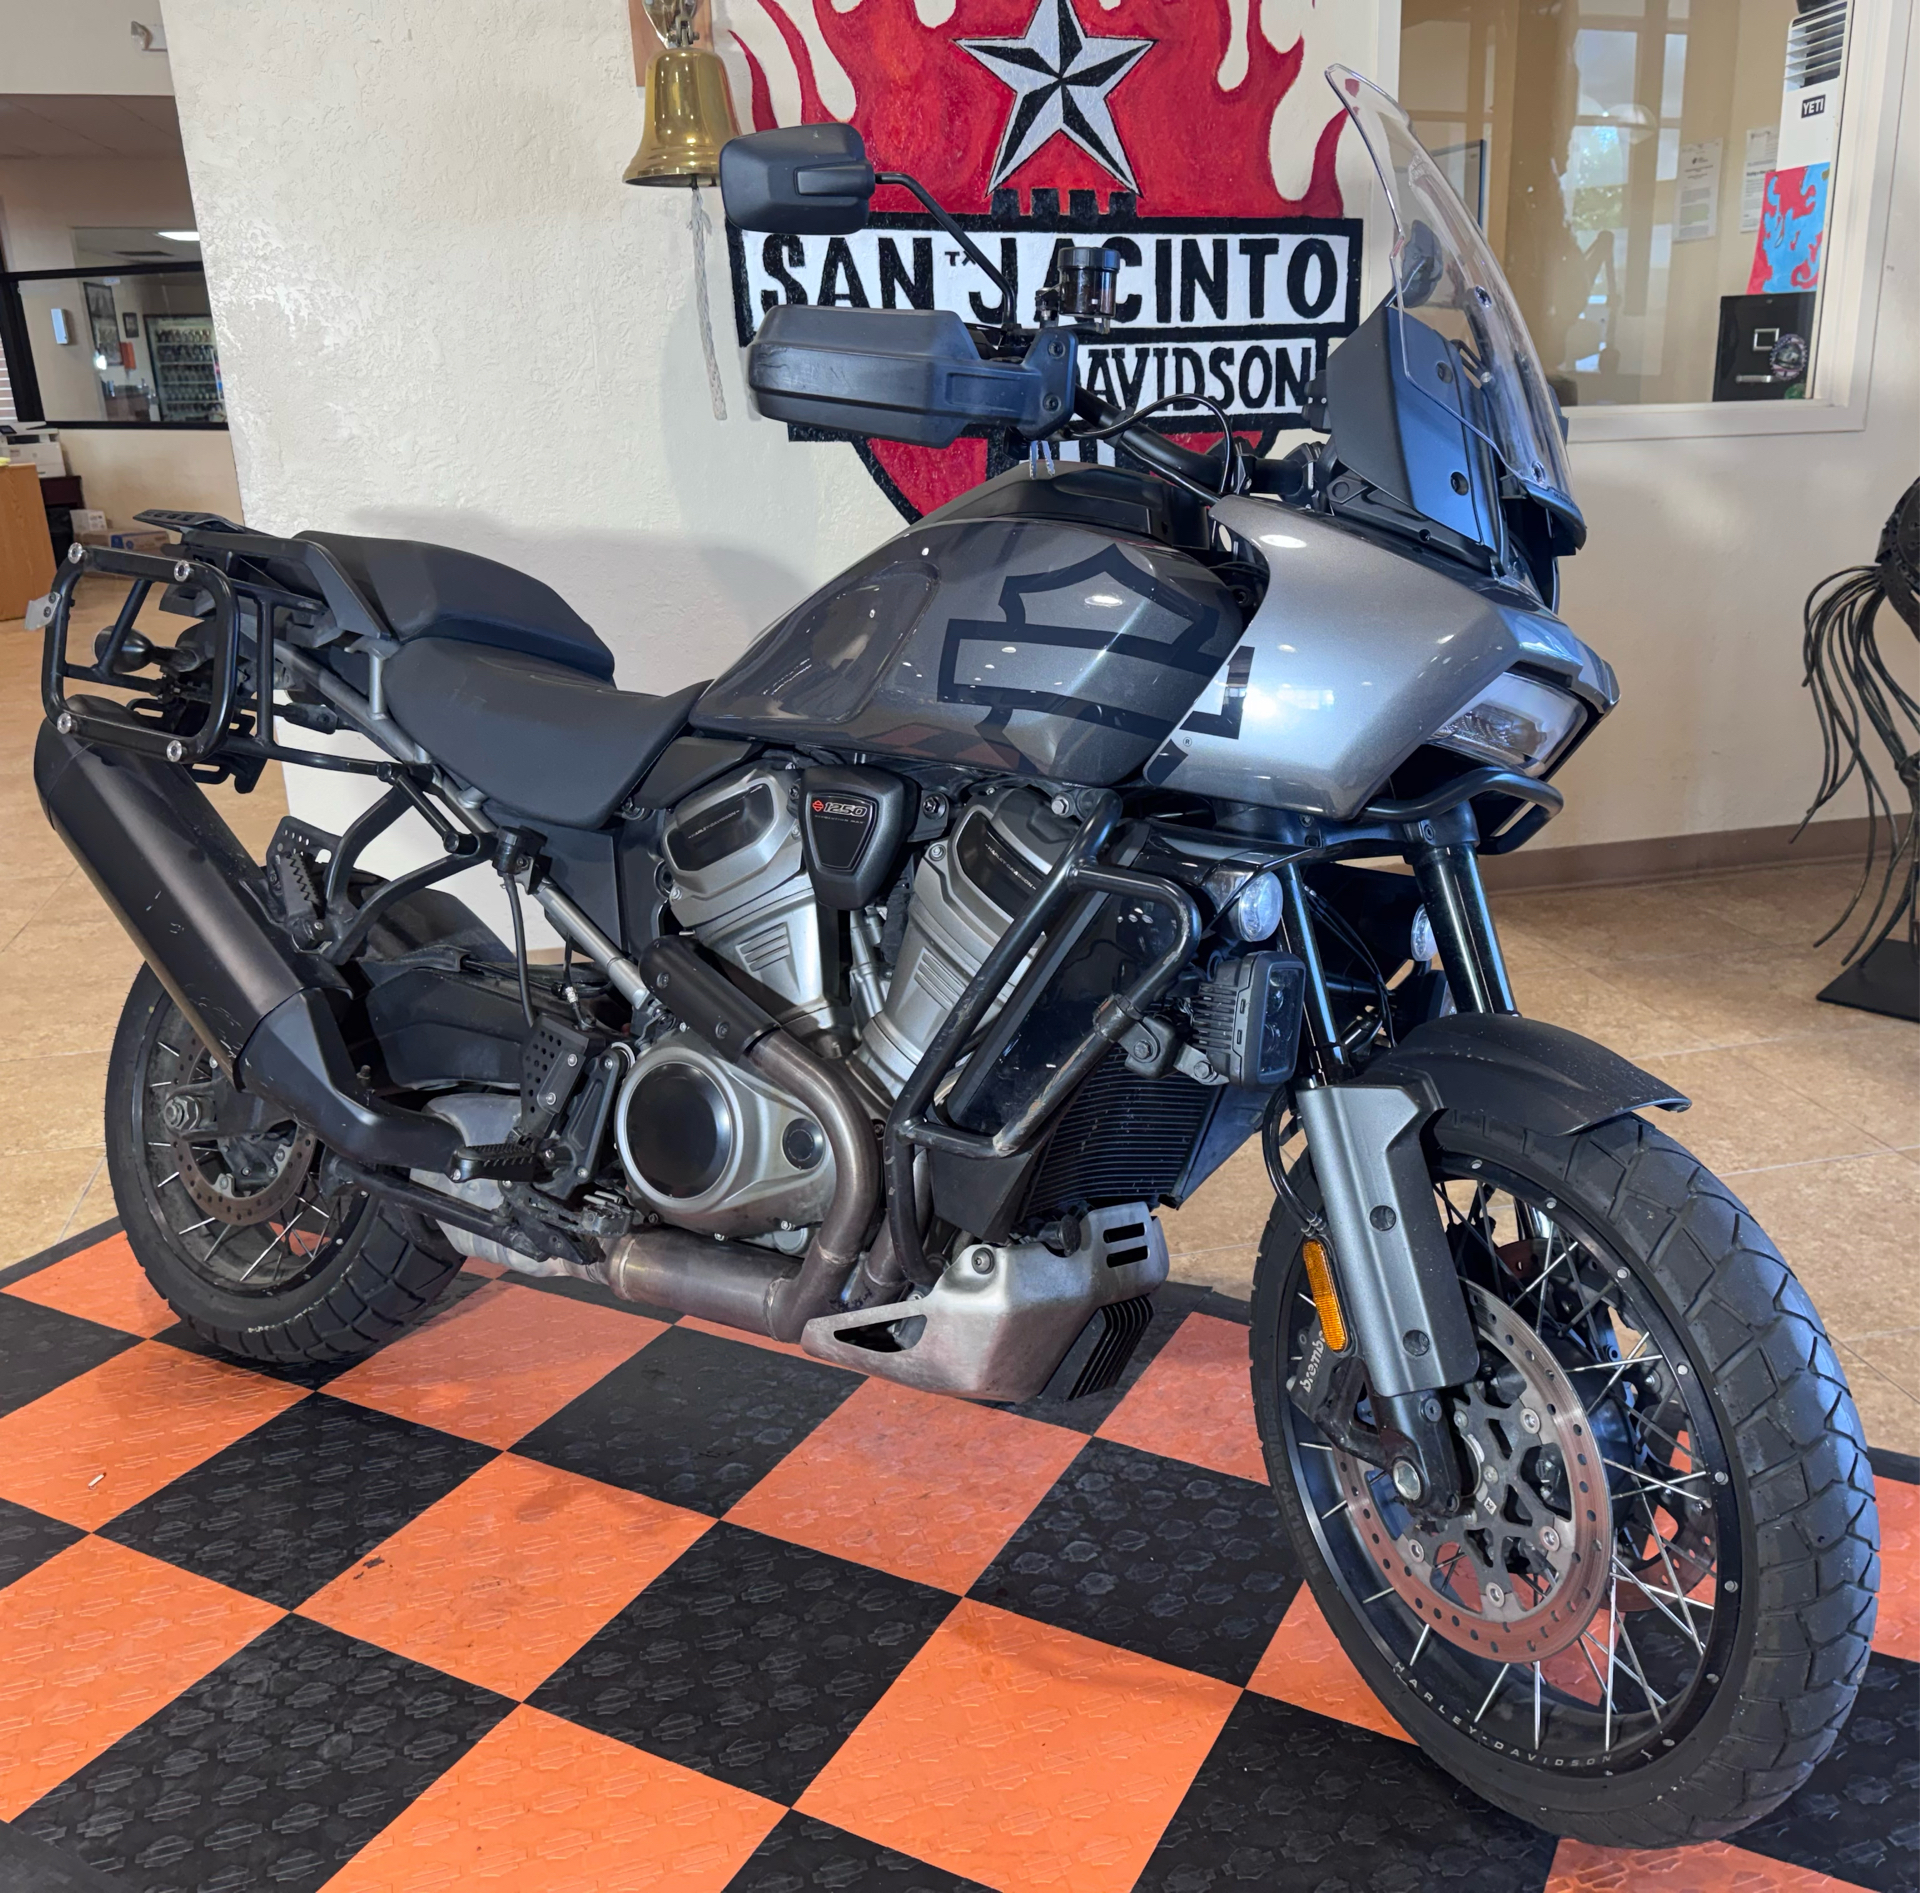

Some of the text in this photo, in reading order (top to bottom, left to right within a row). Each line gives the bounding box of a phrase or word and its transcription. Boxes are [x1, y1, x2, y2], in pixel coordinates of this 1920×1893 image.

[1802, 98, 1824, 116] YETI
[760, 234, 936, 312] SAN
[1076, 345, 1312, 412] AVIDSON
[823, 802, 868, 818] 1250
